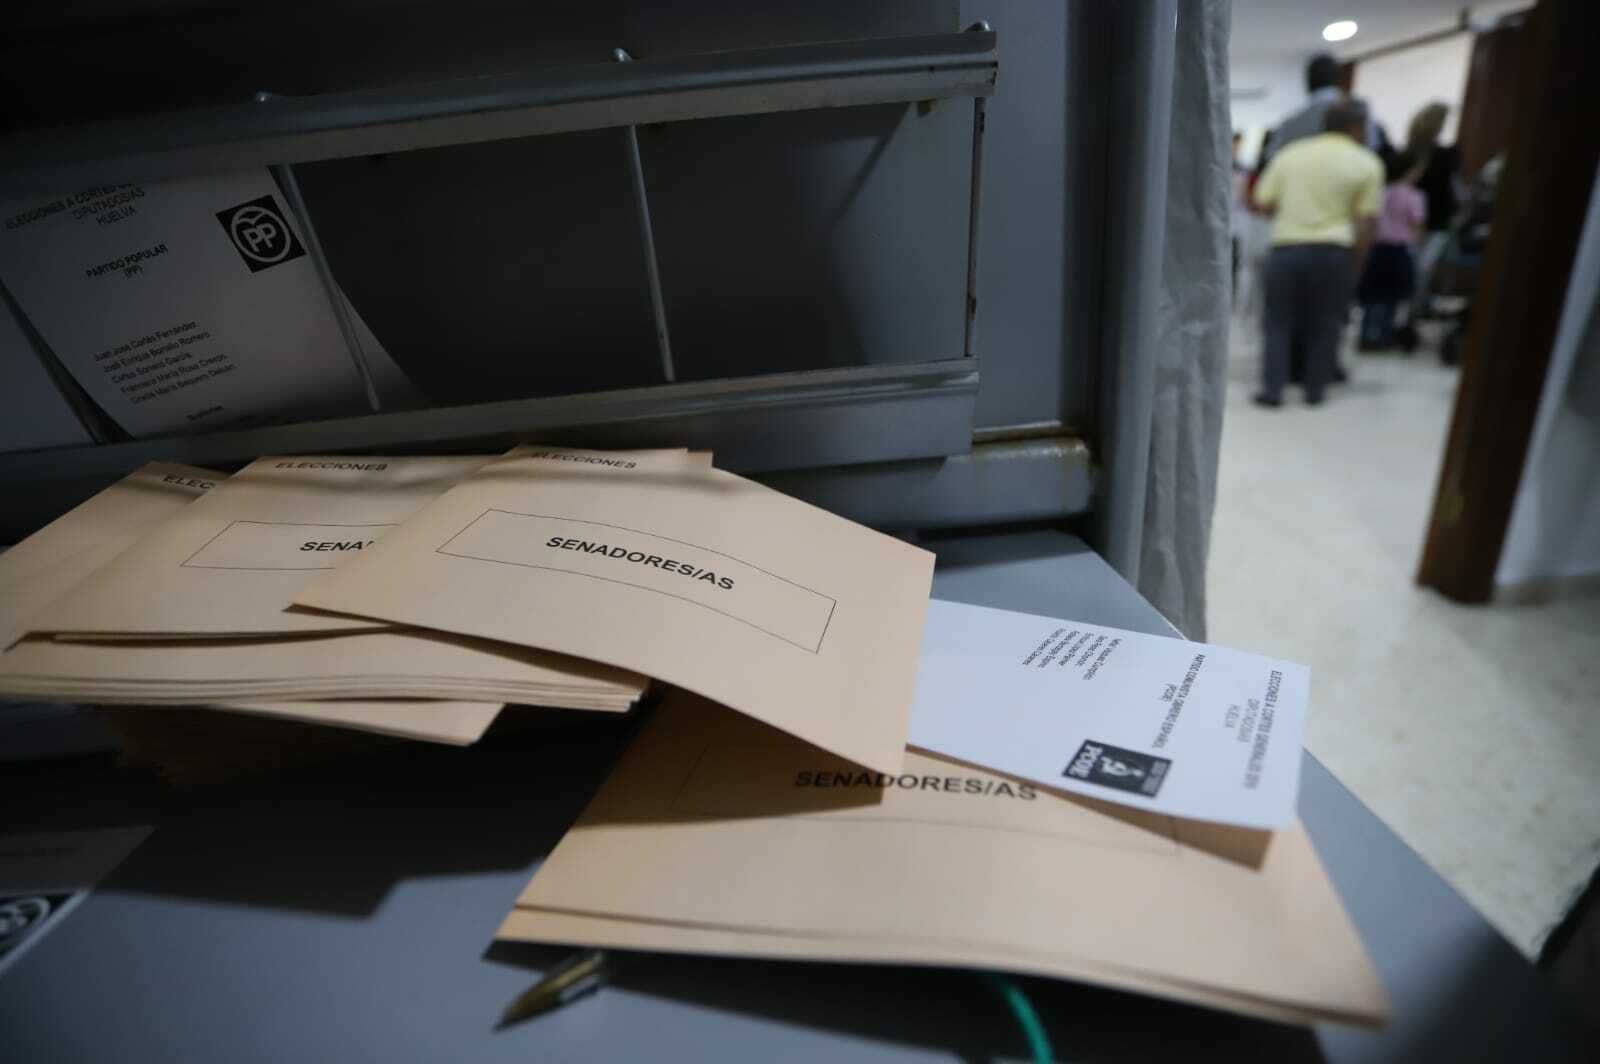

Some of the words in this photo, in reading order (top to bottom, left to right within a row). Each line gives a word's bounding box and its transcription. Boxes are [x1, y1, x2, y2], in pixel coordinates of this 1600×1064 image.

[95, 205, 137, 226] HUELVA
[241, 221, 278, 253] PP
[85, 257, 125, 278] PARTIDO
[124, 243, 169, 265] POPULAR
[275, 462, 388, 472] ELECCIONES
[530, 452, 638, 469] ELECCIONES
[300, 540, 375, 553] SENA
[546, 536, 735, 590] SENADORES/AS
[795, 770, 1038, 801] SENADORES/AS
